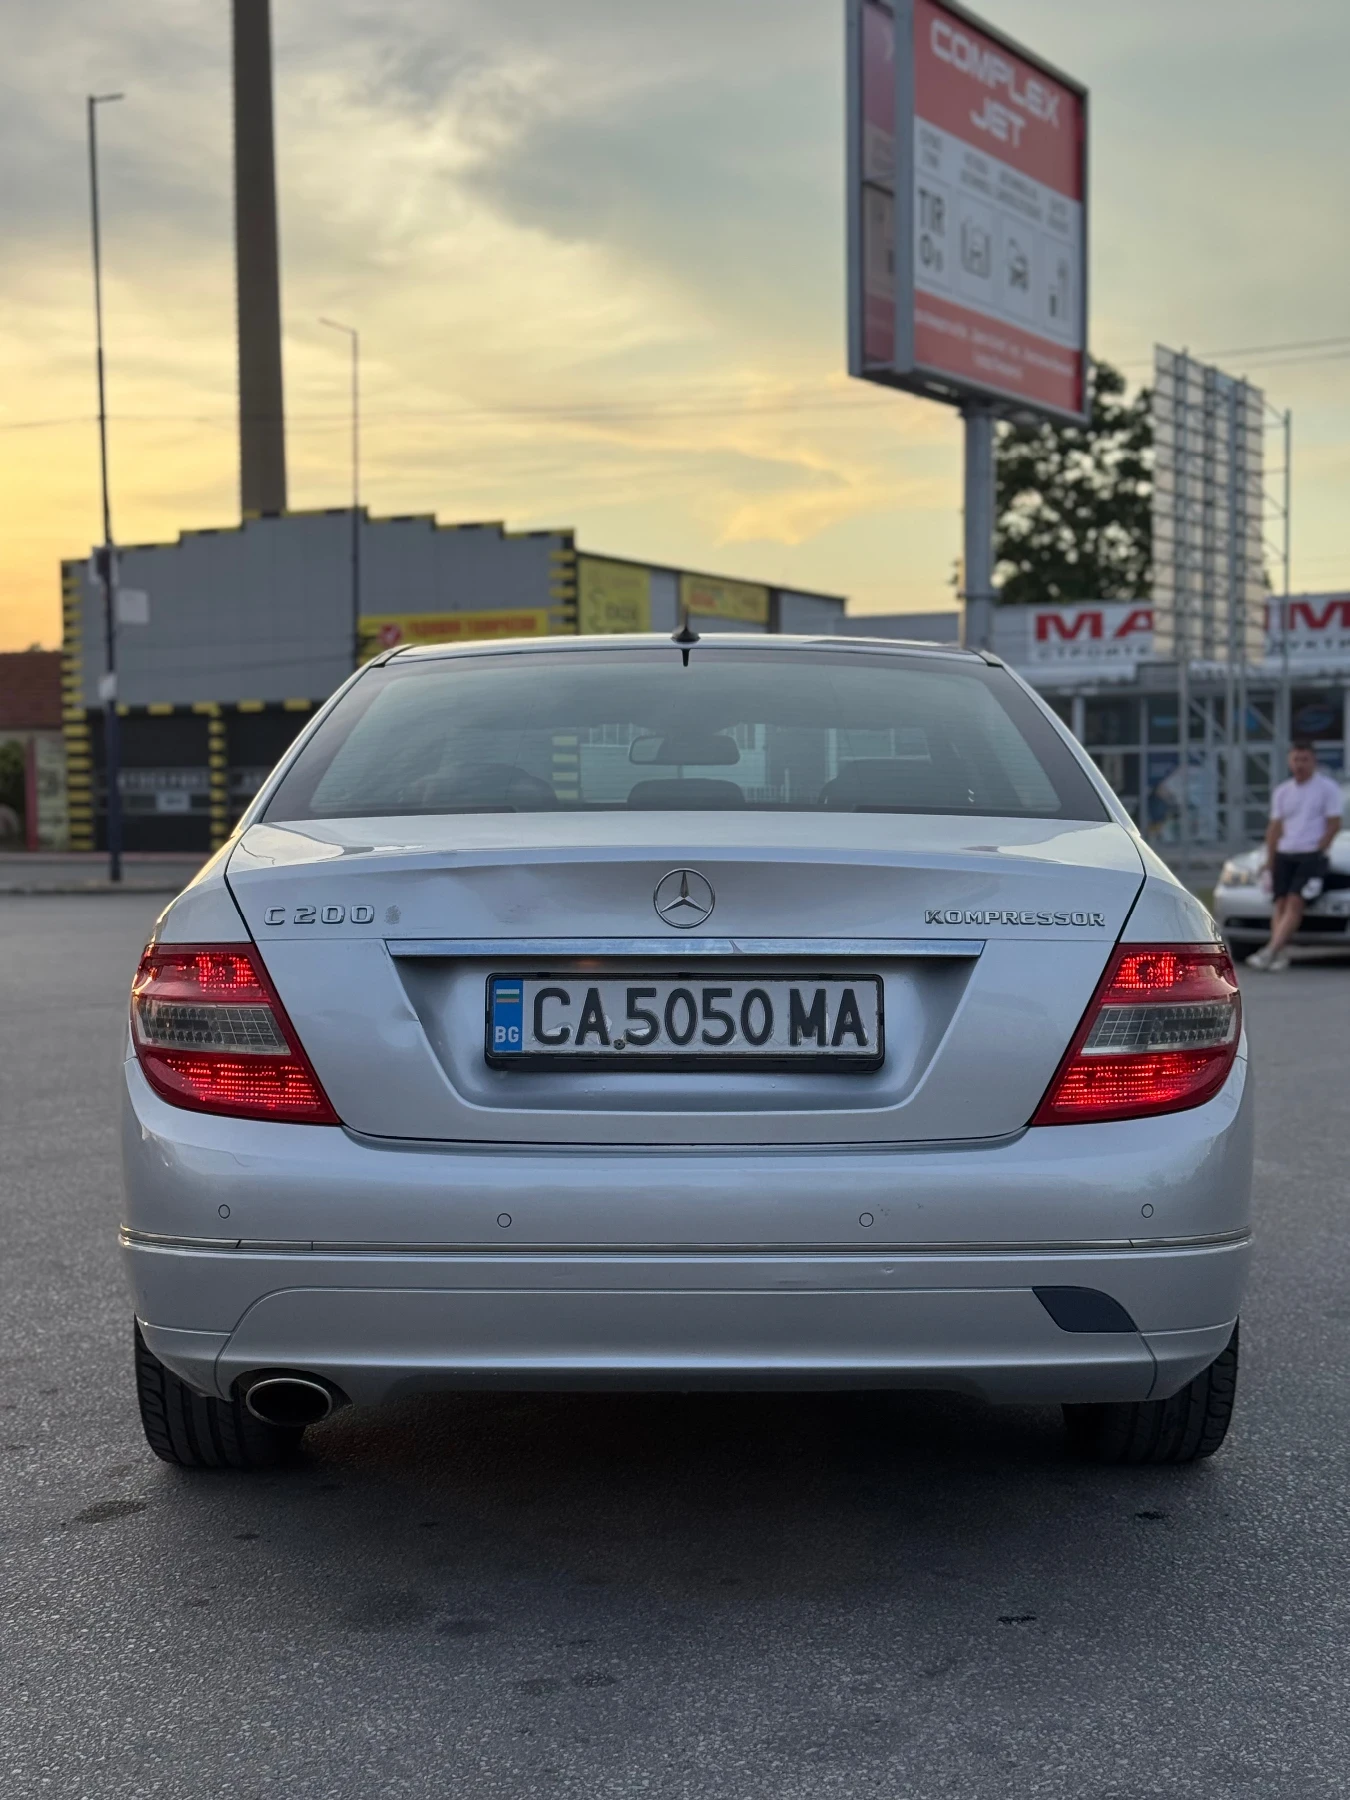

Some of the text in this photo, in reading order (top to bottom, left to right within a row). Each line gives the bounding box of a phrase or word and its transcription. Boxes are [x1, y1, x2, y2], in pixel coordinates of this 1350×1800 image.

[930, 18, 1060, 128] COMPLEX
[969, 97, 1026, 147] JET
[264, 904, 375, 925] C 200
[924, 909, 1105, 926] KOMPRESSOR
[494, 1025, 520, 1043] BG
